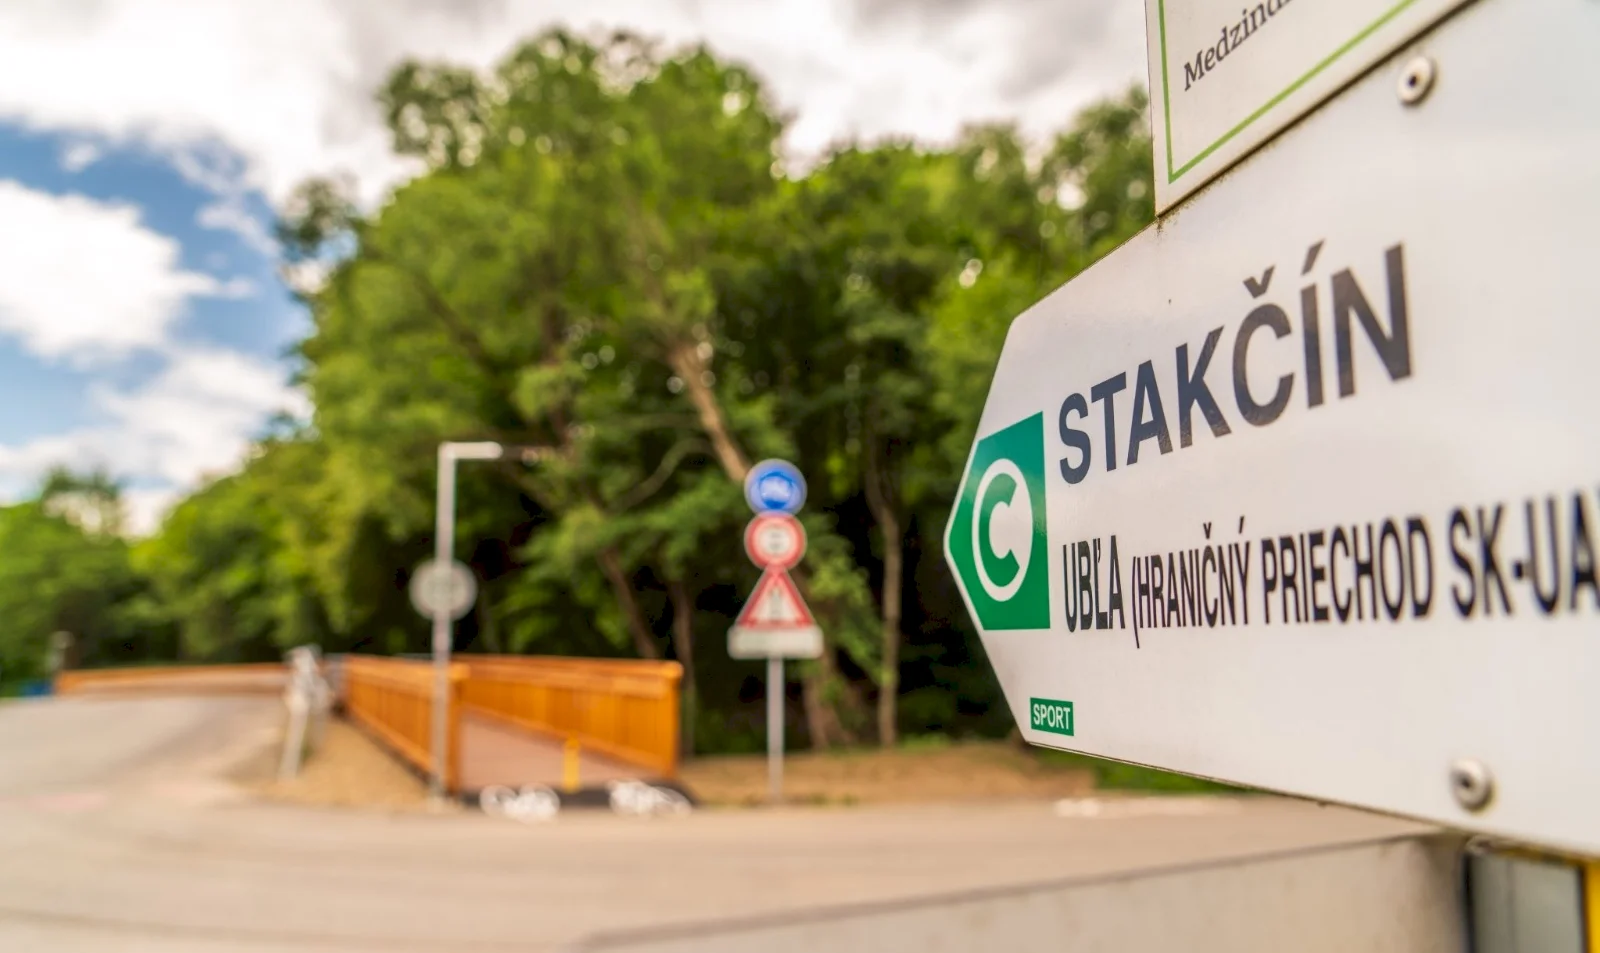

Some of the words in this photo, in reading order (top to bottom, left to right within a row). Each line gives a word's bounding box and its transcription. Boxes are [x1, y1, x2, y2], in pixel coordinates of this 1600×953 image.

[1059, 240, 1413, 484] STAKČÍN
[1062, 535, 1125, 632] UBĽA
[1132, 516, 1250, 649] (HRANIČNÝ
[1261, 515, 1432, 624] PRIECHOD
[1449, 488, 1600, 622] SK-UA
[1033, 703, 1071, 730] SPORT
